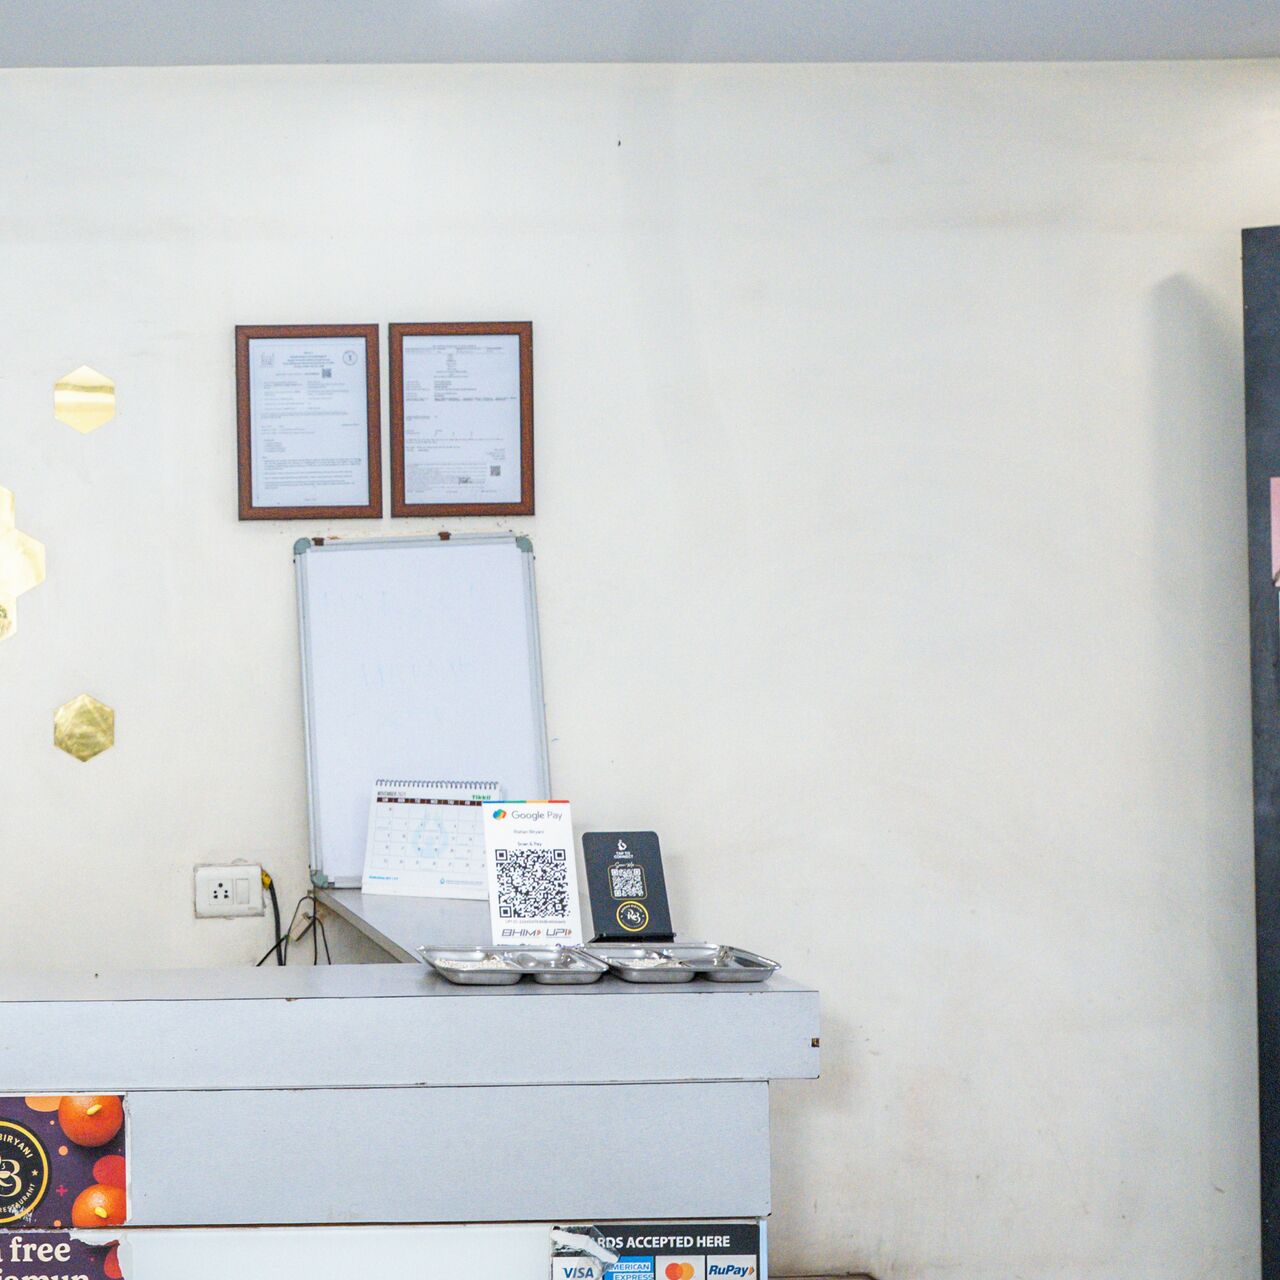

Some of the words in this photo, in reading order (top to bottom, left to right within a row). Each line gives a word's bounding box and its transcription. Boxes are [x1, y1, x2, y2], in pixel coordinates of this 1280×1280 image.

[512, 810, 545, 821] Google
[547, 810, 562, 821] Pay
[502, 928, 536, 936] BHIM
[546, 928, 568, 936] UPI
[626, 1236, 694, 1249] ACCEPTED
[696, 1235, 731, 1247] HERE
[9, 1236, 71, 1263] free
[562, 1267, 594, 1279] VISA
[708, 1265, 748, 1278] RuPay
